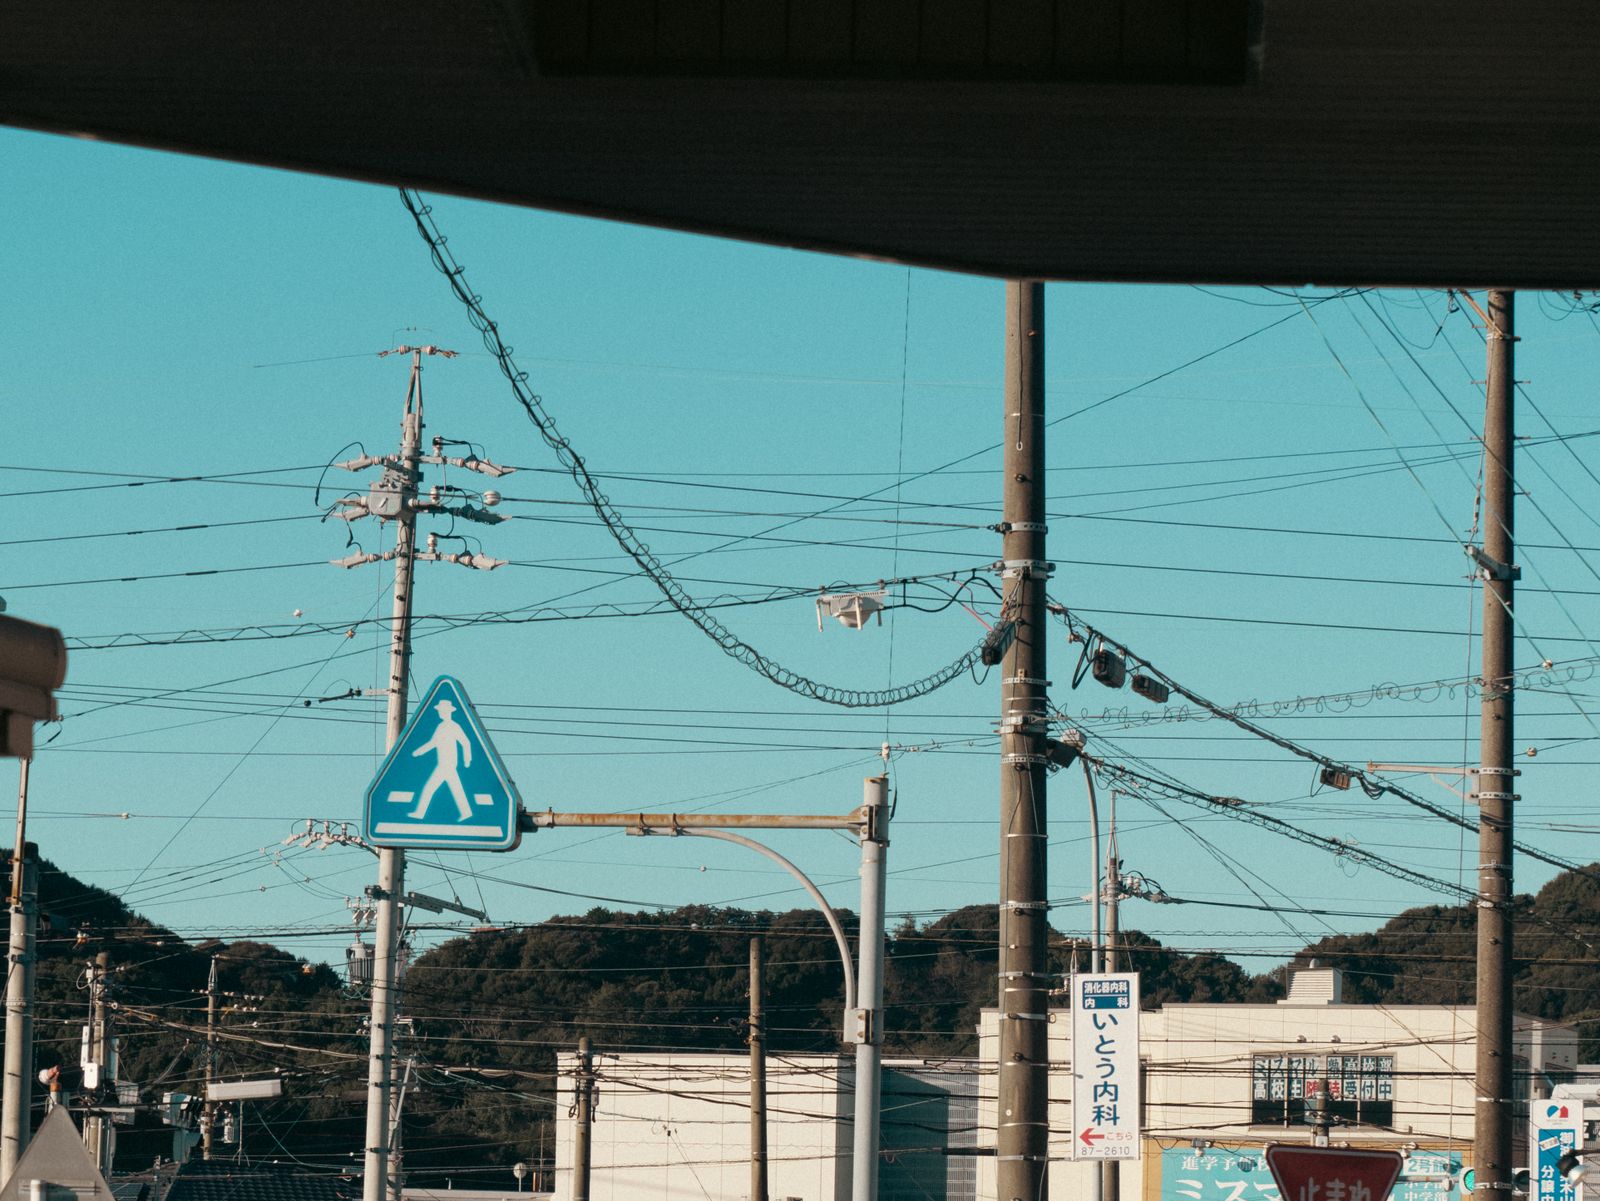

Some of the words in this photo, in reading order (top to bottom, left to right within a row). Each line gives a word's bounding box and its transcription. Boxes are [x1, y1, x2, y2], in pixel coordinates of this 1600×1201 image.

[1084, 982, 1128, 994] 消化器内科
[1085, 997, 1128, 1008] 内科
[1092, 1013, 1120, 1126] いとう内科
[1106, 1131, 1133, 1141] こちら
